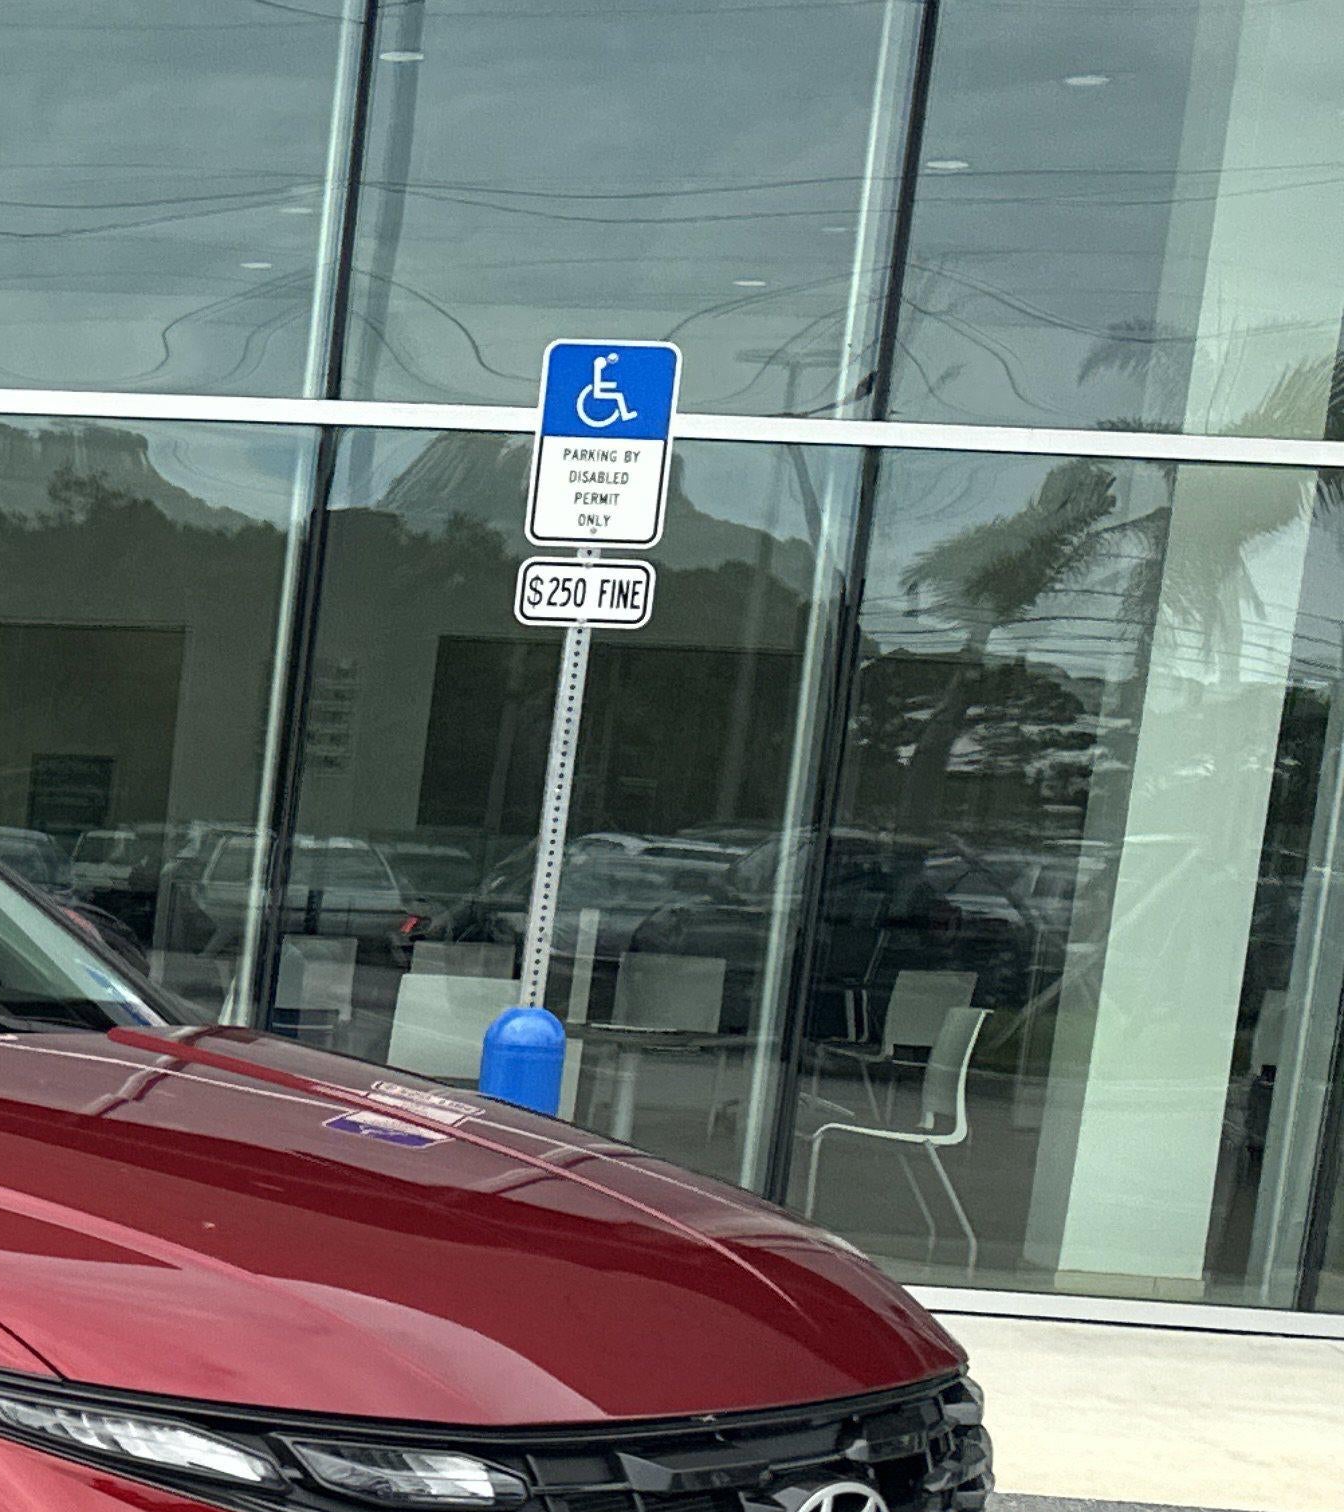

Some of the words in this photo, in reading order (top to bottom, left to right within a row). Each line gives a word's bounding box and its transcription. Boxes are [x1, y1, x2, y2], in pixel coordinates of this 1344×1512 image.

[562, 448, 618, 463] PARKING
[623, 450, 641, 463] BY
[568, 470, 630, 485] DISABLED
[574, 491, 620, 506] PERMIT
[578, 513, 611, 527] ONLY
[527, 574, 587, 609] $250
[598, 579, 643, 609] FINE
